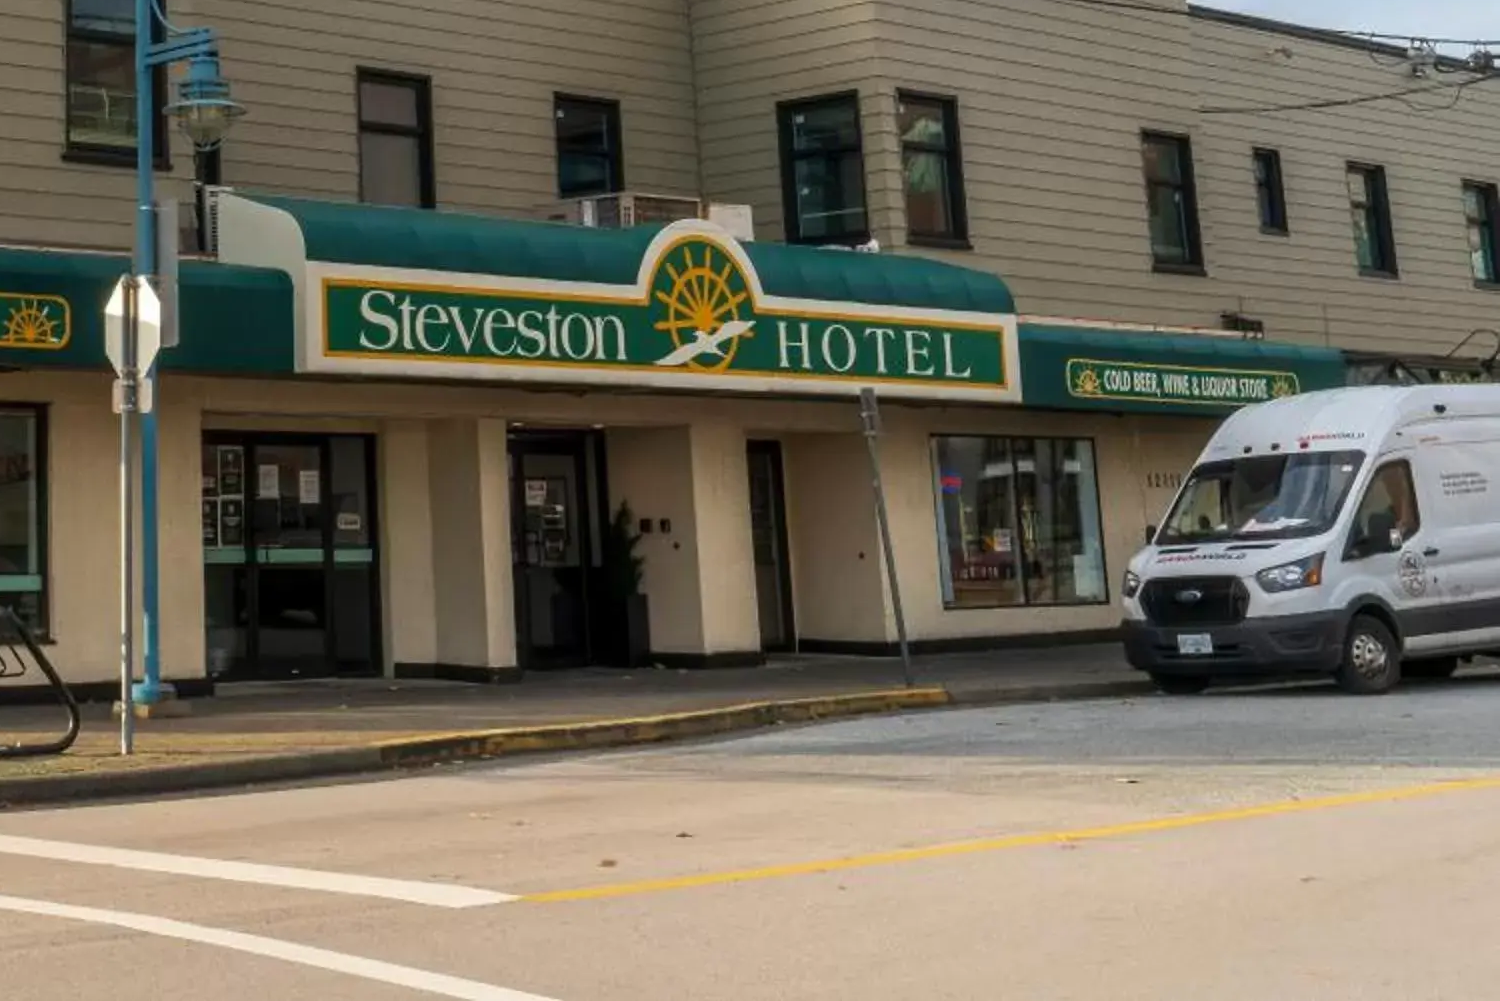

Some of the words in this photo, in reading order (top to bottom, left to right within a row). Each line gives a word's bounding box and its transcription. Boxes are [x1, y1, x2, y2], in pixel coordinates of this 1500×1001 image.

[359, 289, 628, 361] Steveston
[776, 320, 972, 378] HOTEL
[1103, 369, 1131, 392] COLD
[1133, 370, 1161, 397] BEER,
[1163, 373, 1190, 396] WINE
[1192, 375, 1200, 396] &
[1201, 377, 1239, 398] LIQUOR
[1239, 378, 1268, 399] STORE
